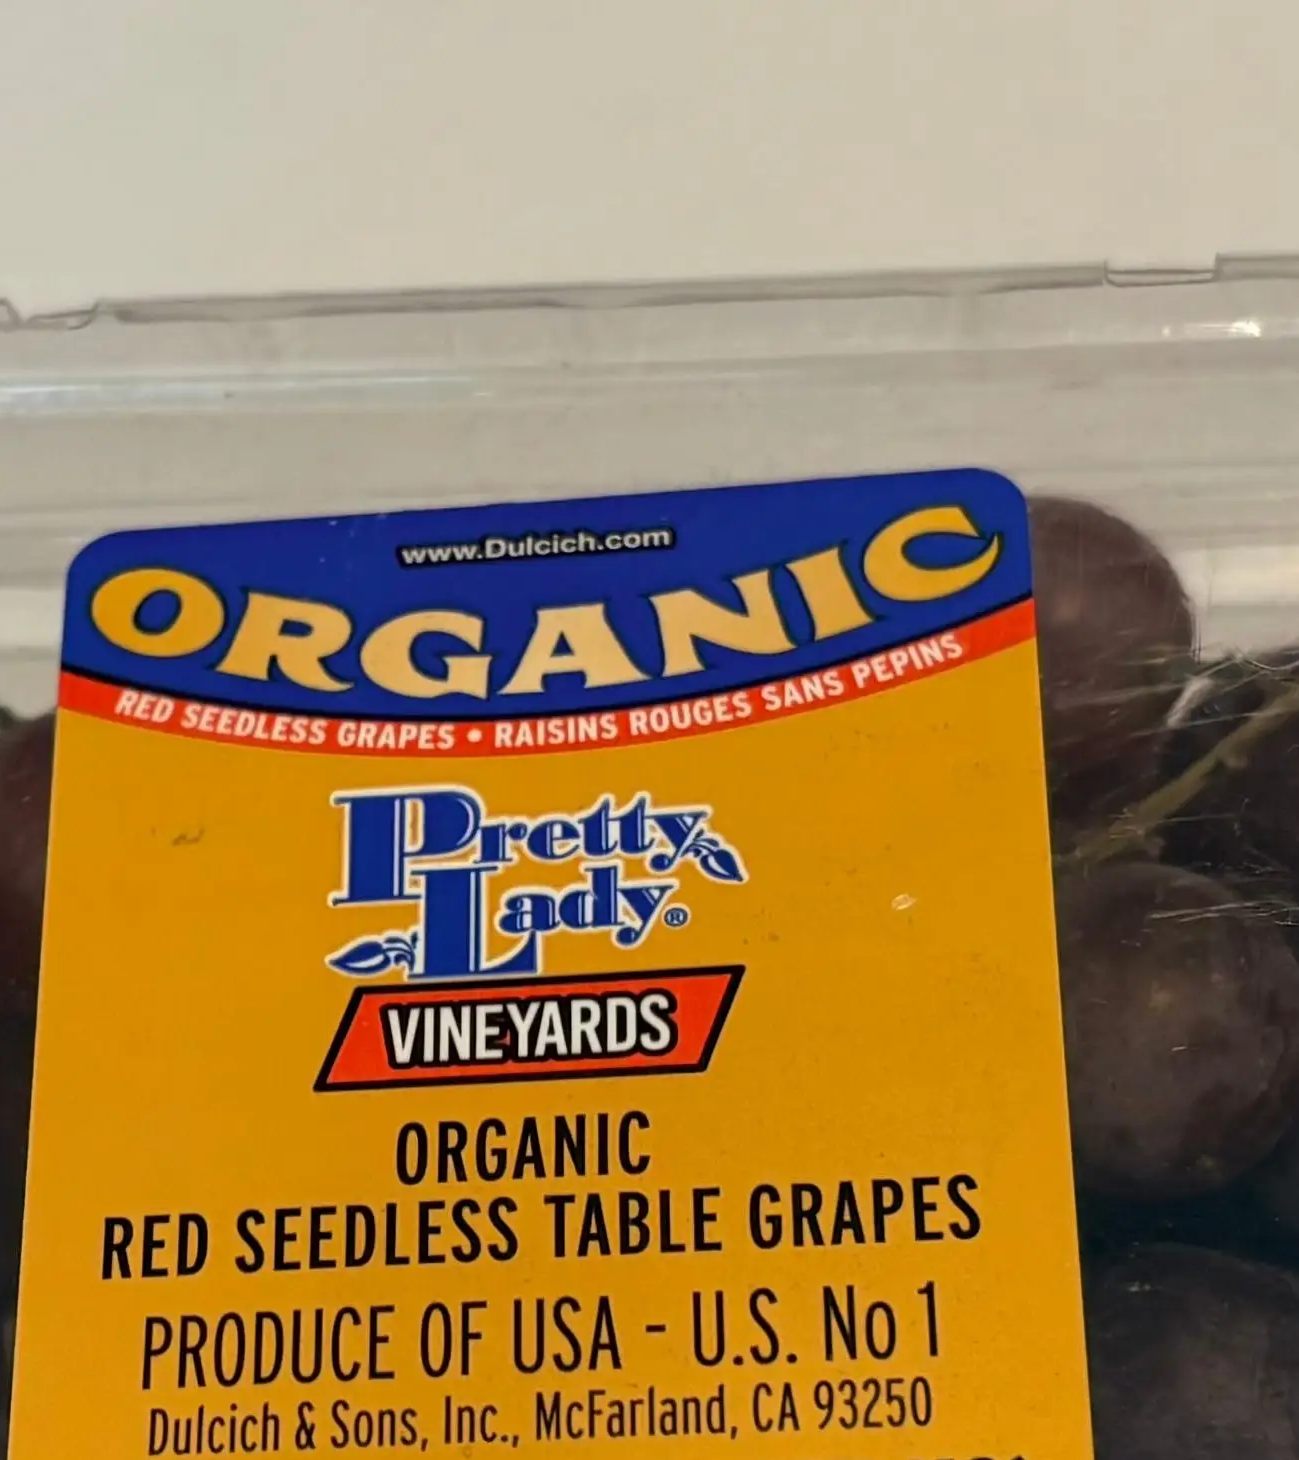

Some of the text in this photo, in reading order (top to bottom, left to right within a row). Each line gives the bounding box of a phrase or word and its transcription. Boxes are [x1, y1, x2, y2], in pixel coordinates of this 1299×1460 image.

[401, 527, 671, 564] www.Dulcich.com
[90, 504, 1000, 701] ORGANIC
[114, 689, 174, 724] RED
[180, 702, 327, 745] SEEDLESS
[337, 721, 455, 750] GRAPES
[494, 713, 618, 748] RAISINS
[629, 695, 752, 738] ROUGES
[761, 669, 845, 712] SANS
[853, 632, 964, 690] PEPINS
[331, 784, 712, 907] Pretty
[387, 993, 672, 1064] VINEYARDS
[395, 1110, 651, 1187] ORGANIC
[102, 1174, 982, 1281] RED SEEDLESS TABLE GRAPES
[141, 1304, 396, 1391] PRODUCE
[420, 1301, 488, 1379] OF
[512, 1295, 623, 1375] USA
[692, 1288, 798, 1367] U.S.
[822, 1285, 897, 1362] No
[918, 1281, 939, 1357] 1
[148, 1377, 933, 1456] Dulcich & Sons, Inc., McFarland, CA 93250
